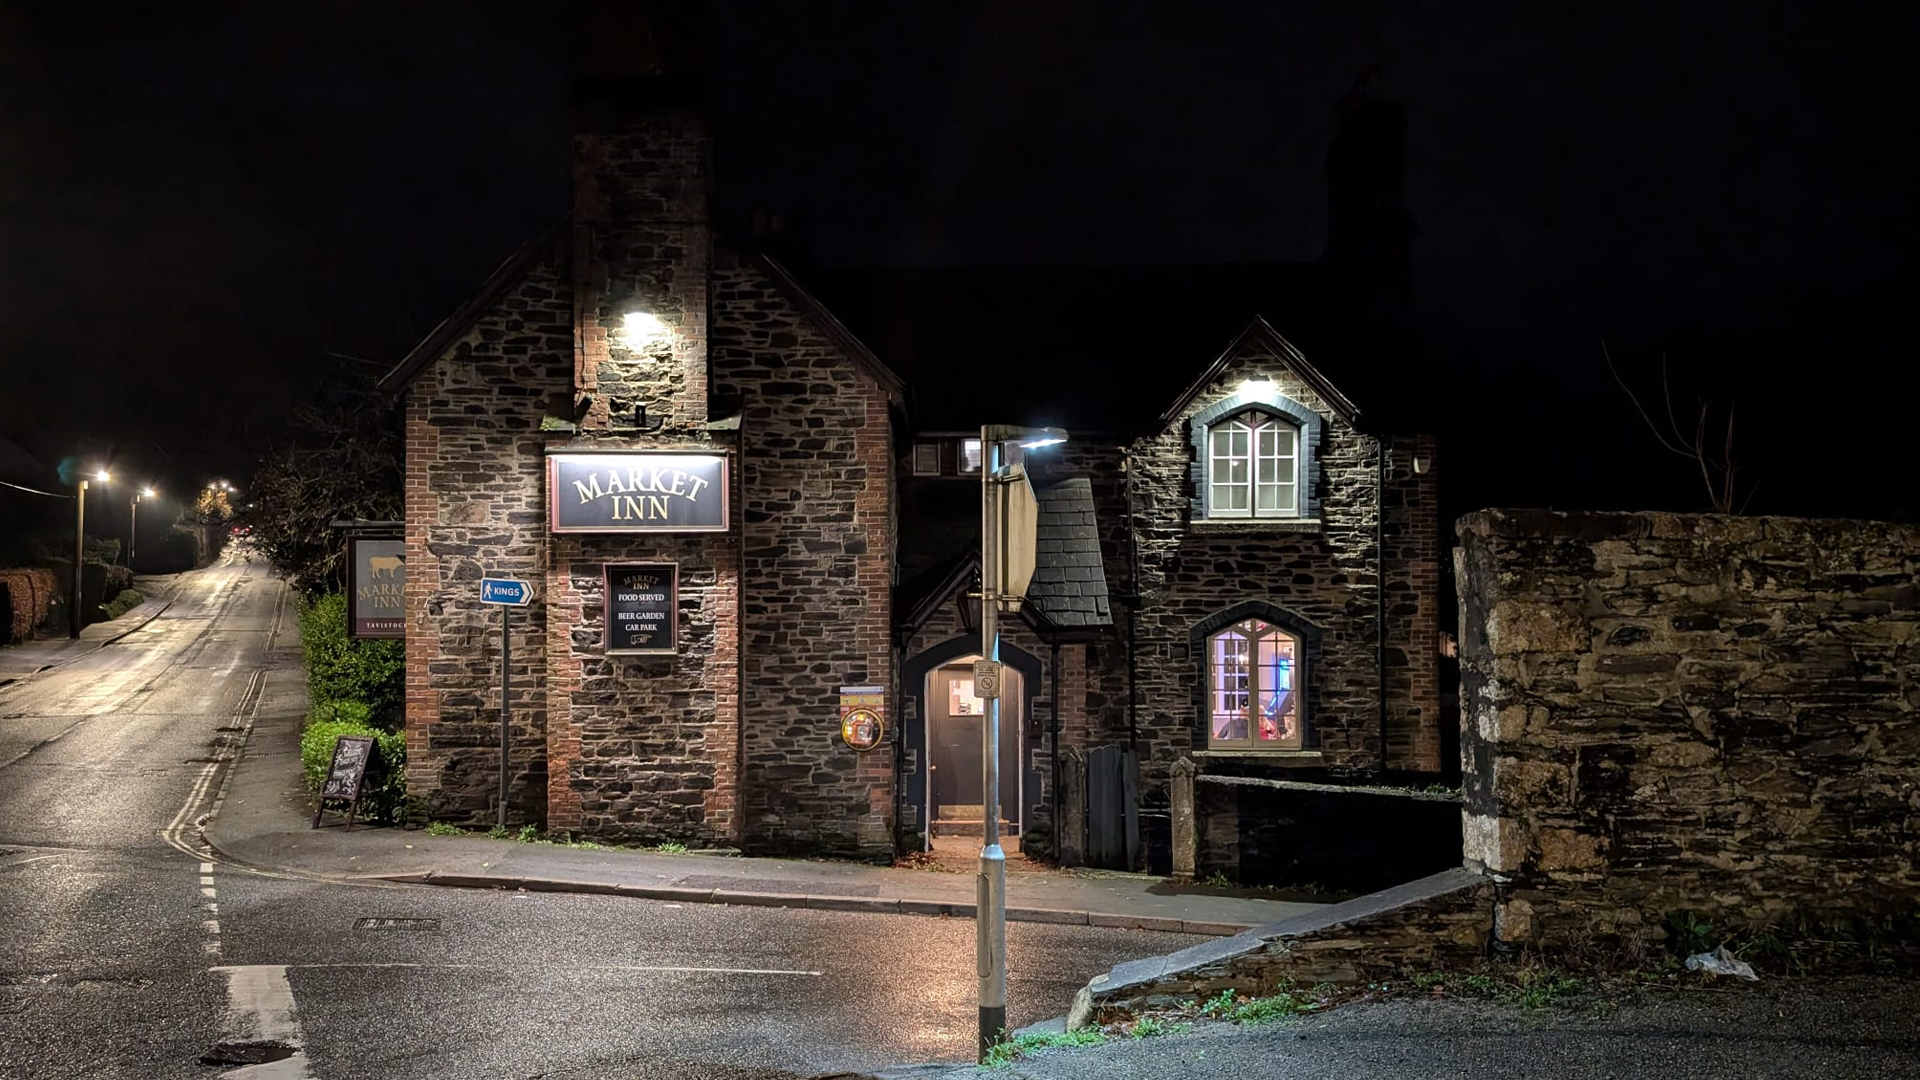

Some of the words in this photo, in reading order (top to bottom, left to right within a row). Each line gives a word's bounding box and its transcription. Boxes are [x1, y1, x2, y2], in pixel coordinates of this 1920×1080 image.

[572, 467, 709, 505] MARKET
[611, 495, 670, 520] INN
[623, 574, 660, 586] MARKET
[494, 586, 520, 597] KINGS
[633, 582, 650, 590] INN
[357, 583, 406, 601] MARK
[618, 593, 638, 601] FOOD
[638, 593, 665, 601] SERVED
[374, 596, 400, 608] INN
[618, 612, 635, 620] BEER
[635, 612, 665, 620] GARDEN
[625, 623, 639, 631] CAR
[640, 623, 658, 631] PARK
